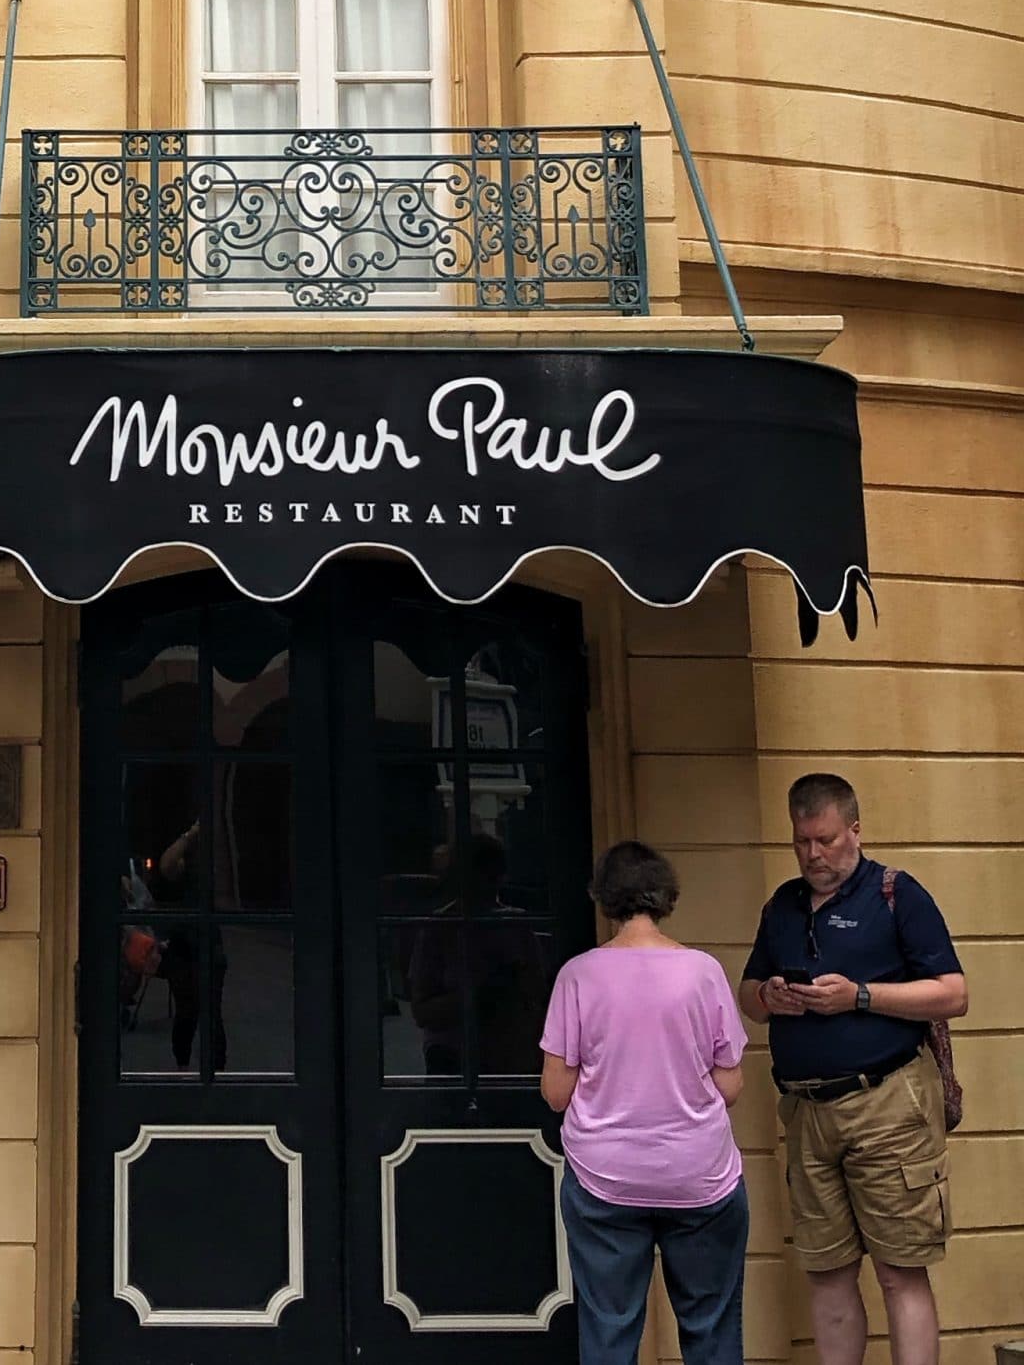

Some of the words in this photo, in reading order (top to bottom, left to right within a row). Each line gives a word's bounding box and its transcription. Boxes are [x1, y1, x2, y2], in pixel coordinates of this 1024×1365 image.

[69, 394, 421, 487] Monsieur
[428, 376, 661, 481] Paul
[188, 502, 517, 525] RESTAURANT
